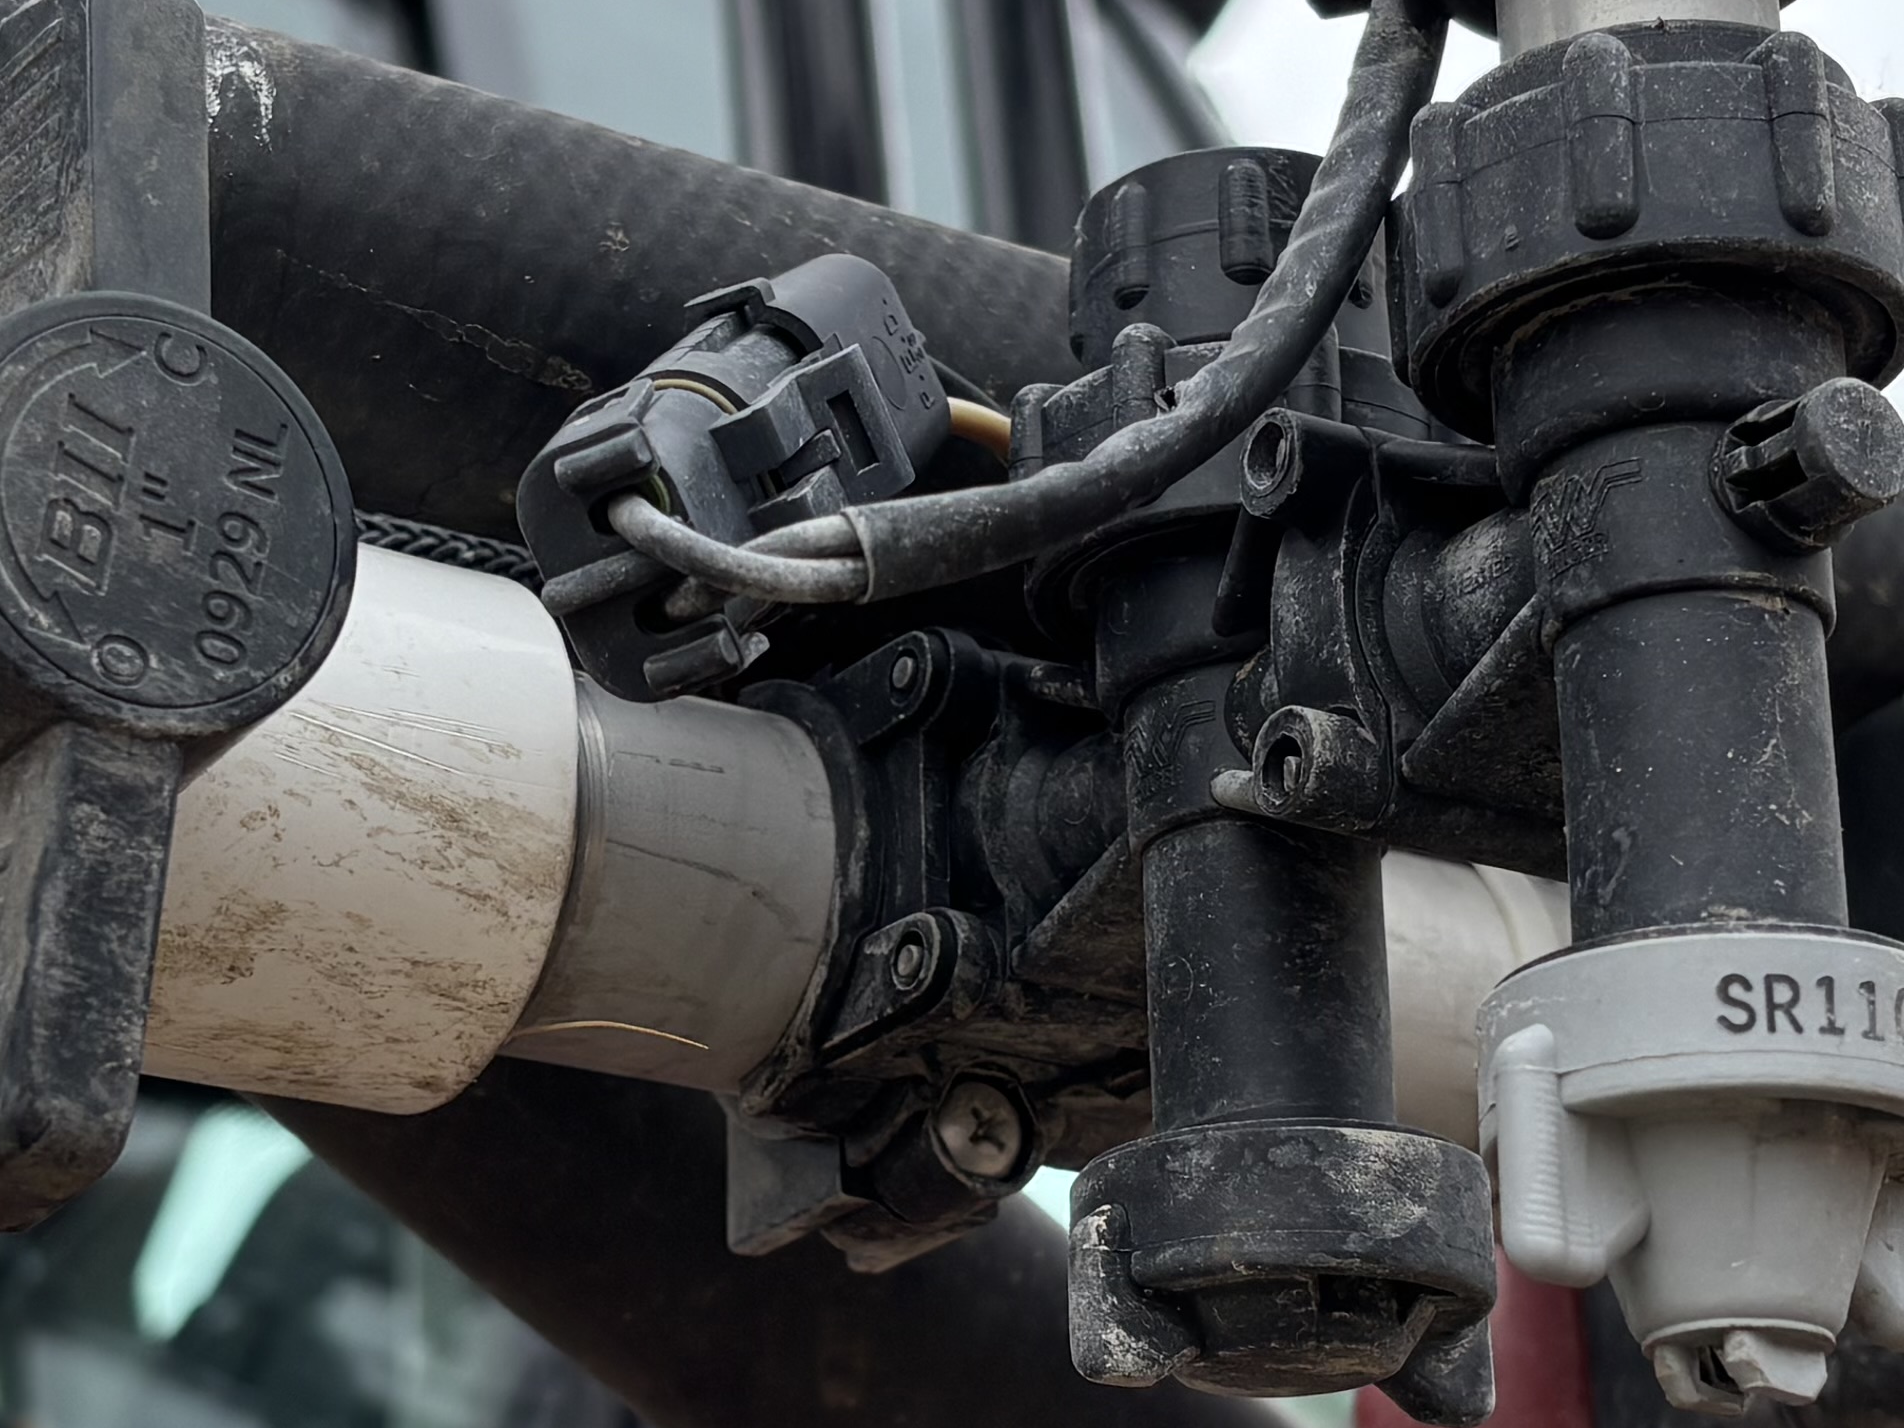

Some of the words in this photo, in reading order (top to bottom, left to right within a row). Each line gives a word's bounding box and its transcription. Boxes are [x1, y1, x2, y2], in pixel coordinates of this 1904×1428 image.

[152, 330, 209, 387] C
[222, 422, 290, 504] NL
[195, 510, 271, 668] 0929
